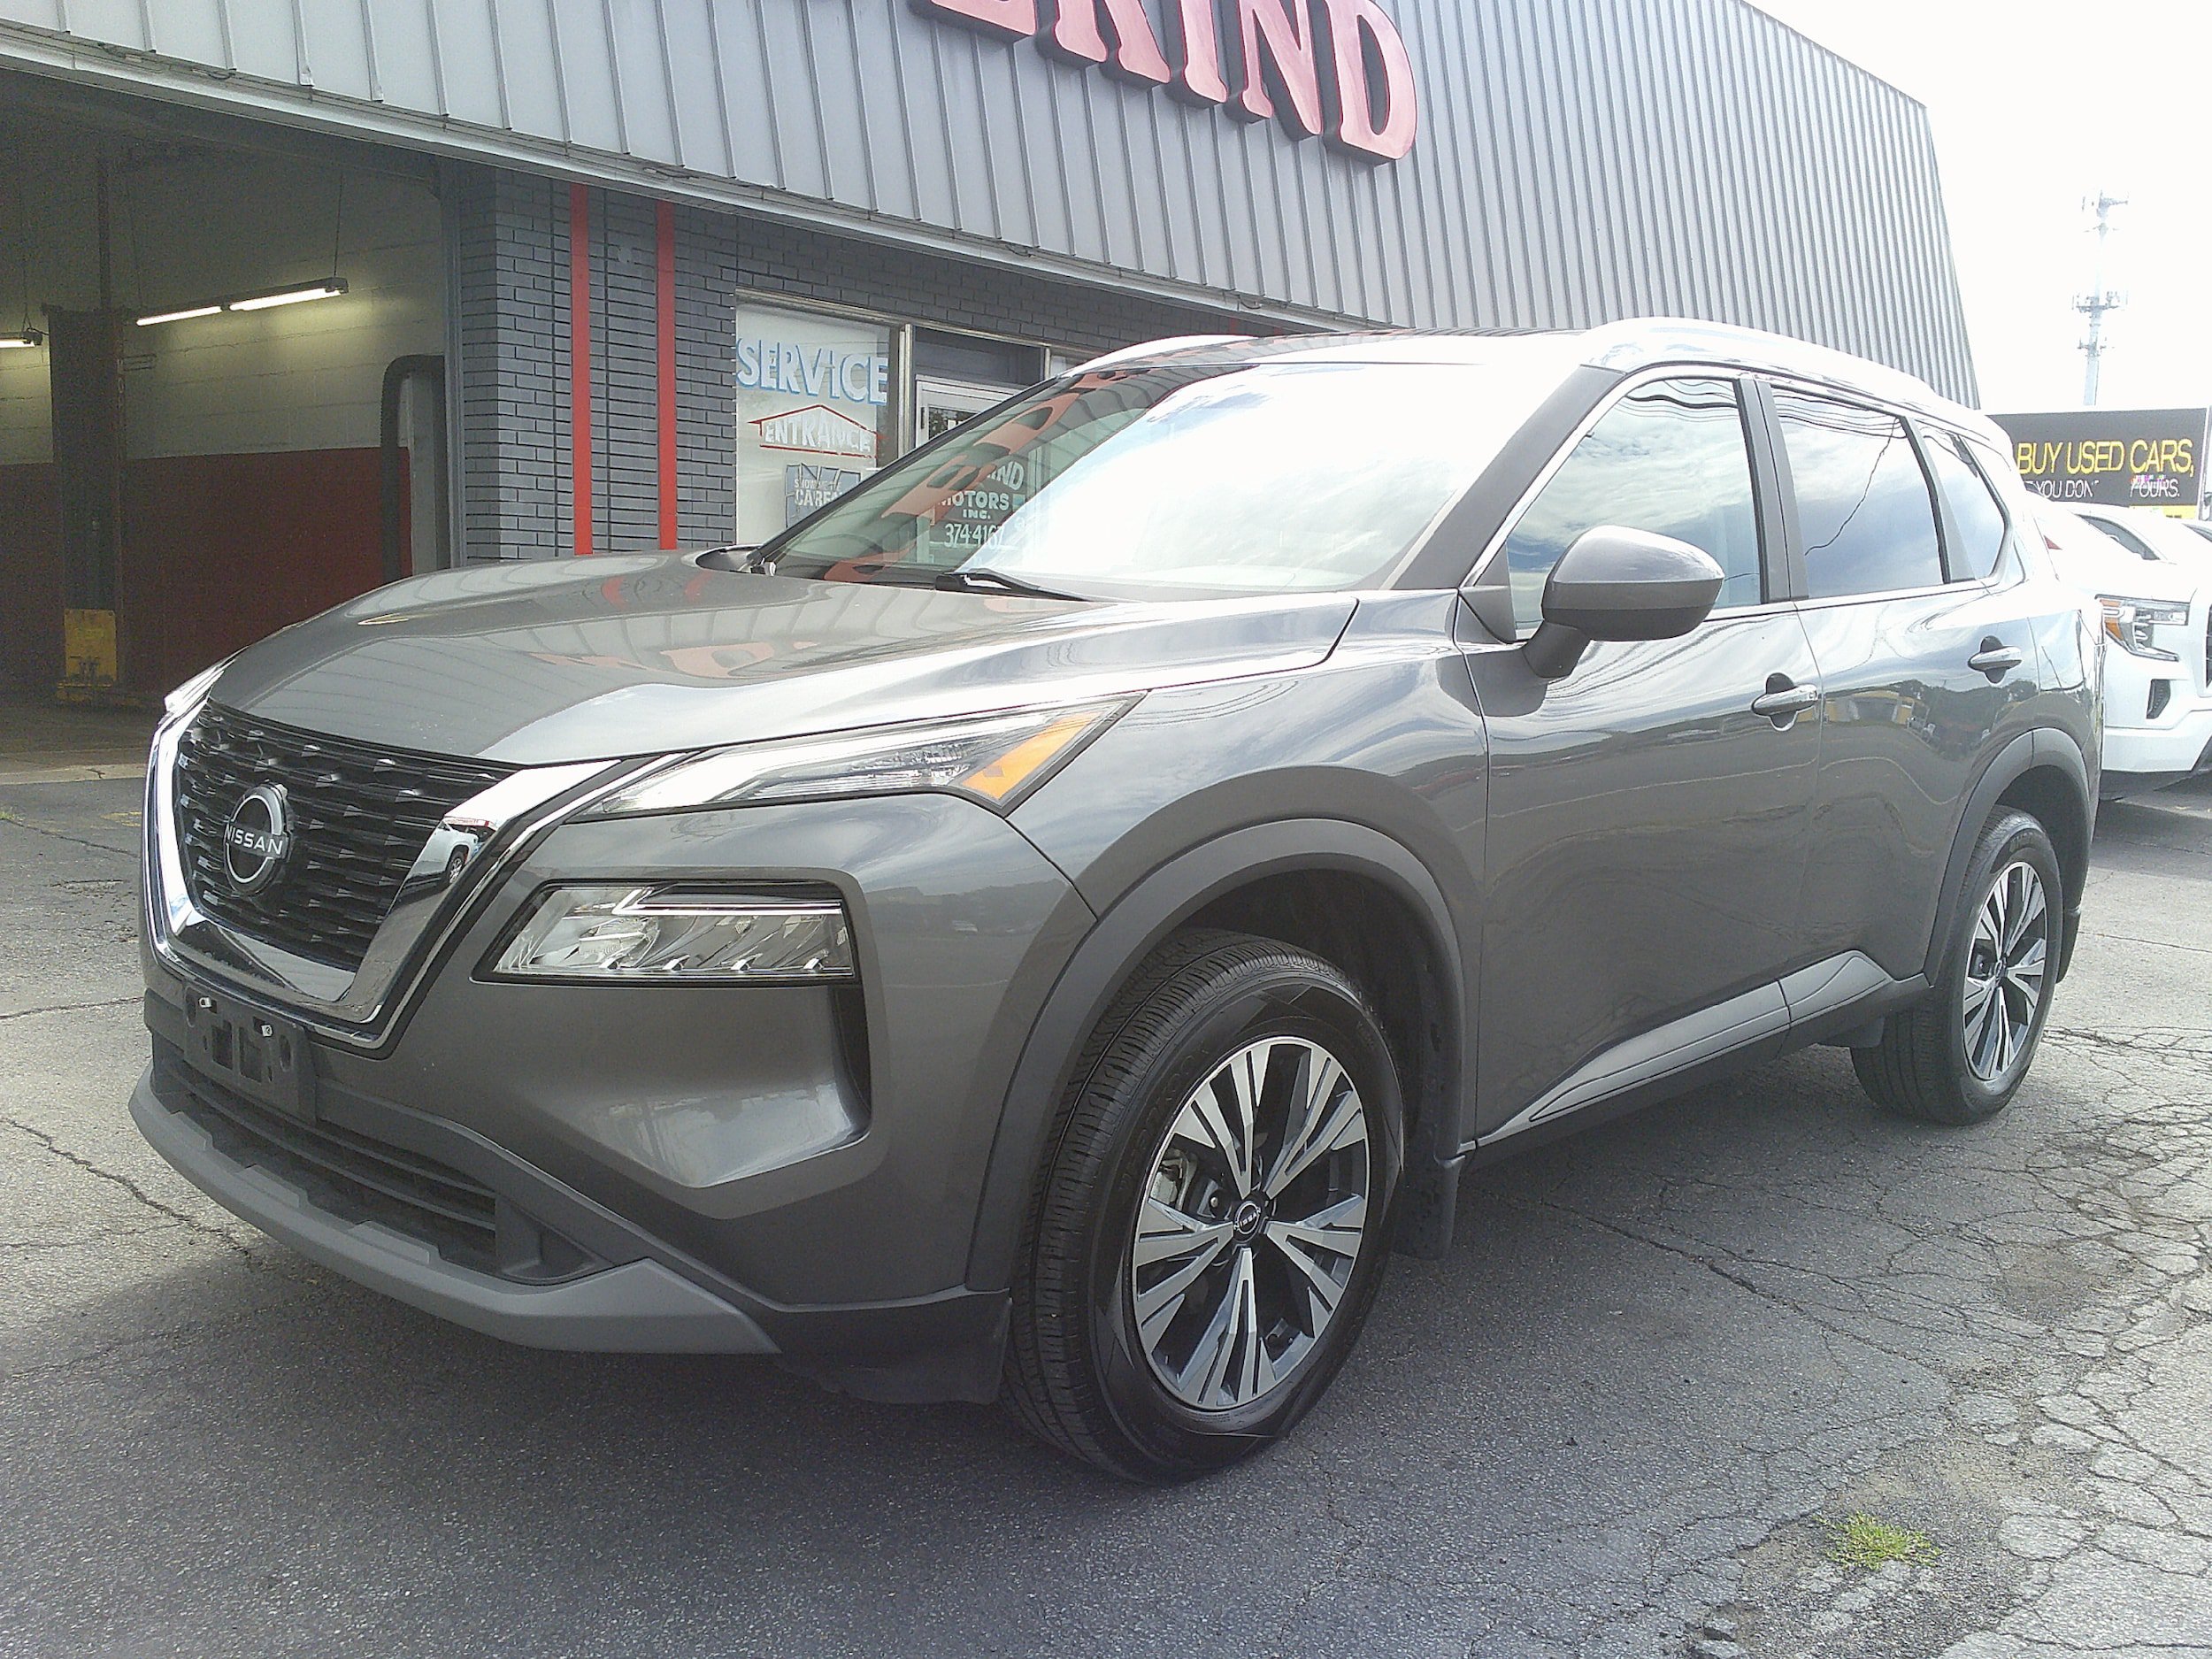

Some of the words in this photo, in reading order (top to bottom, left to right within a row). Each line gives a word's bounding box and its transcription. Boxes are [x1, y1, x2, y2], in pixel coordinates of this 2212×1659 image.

[931, 0, 1418, 161] IND
[736, 338, 888, 405] SERVICE
[764, 408, 872, 452] ENTRANCE
[2016, 442, 2063, 475] BUY
[2066, 440, 2126, 475] USED
[2130, 438, 2194, 478] CARS,
[794, 488, 843, 507] CARF
[2036, 480, 2062, 499] YOU
[963, 509, 991, 519] INC.
[224, 825, 283, 855] NISSAN
[1233, 1206, 1262, 1231] NISSAN
